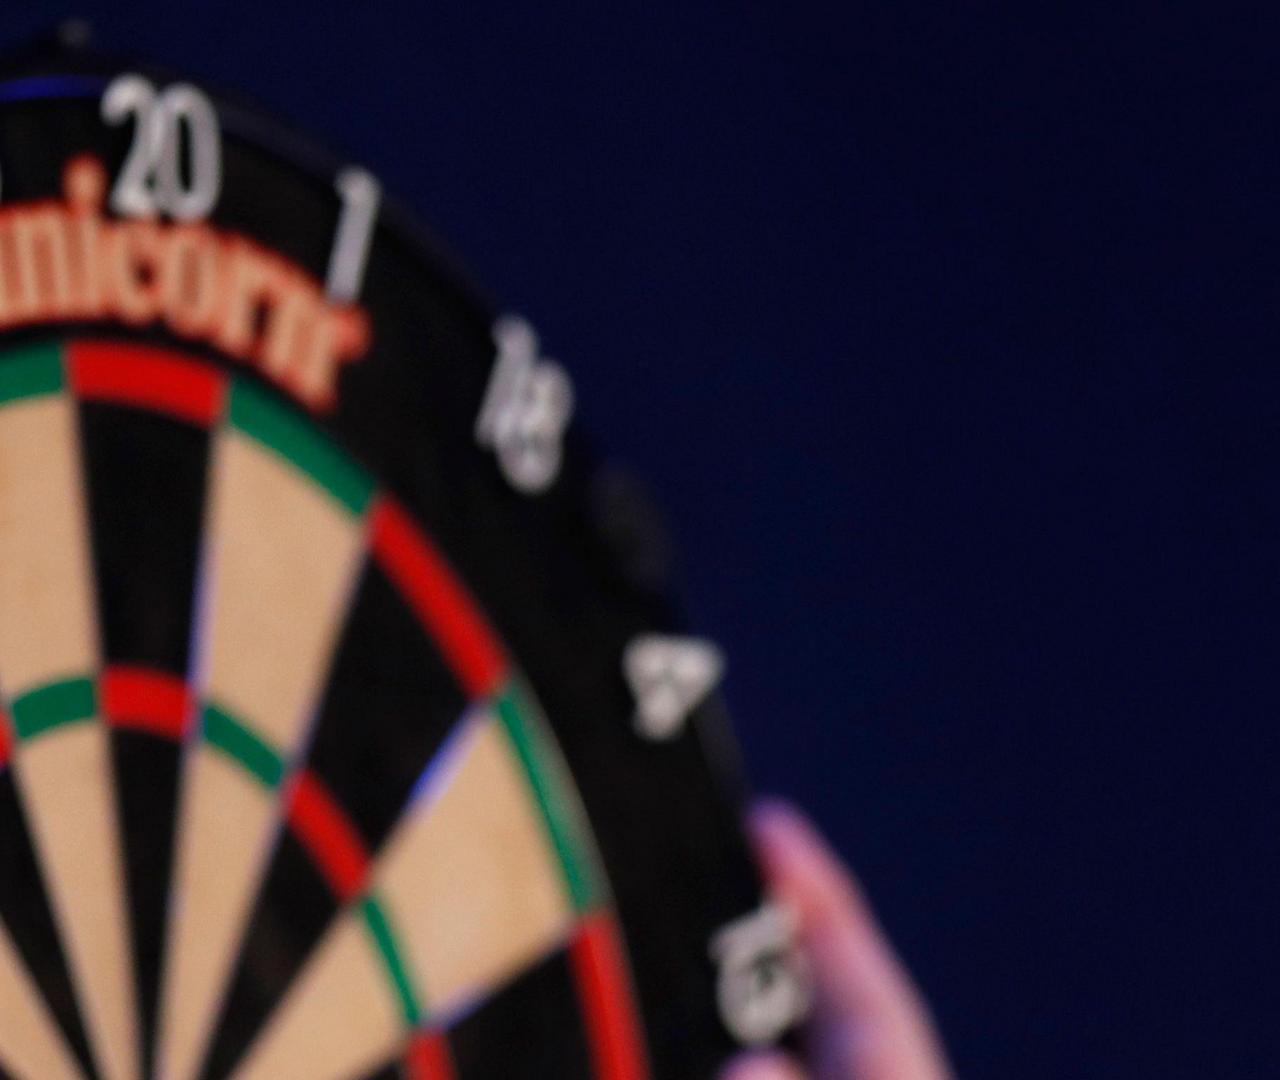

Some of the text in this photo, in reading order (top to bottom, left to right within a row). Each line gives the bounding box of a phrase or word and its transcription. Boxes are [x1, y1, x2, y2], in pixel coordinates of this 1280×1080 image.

[102, 73, 222, 220] 20
[324, 166, 381, 308] 1
[474, 314, 574, 494] 18
[621, 632, 724, 742] 4
